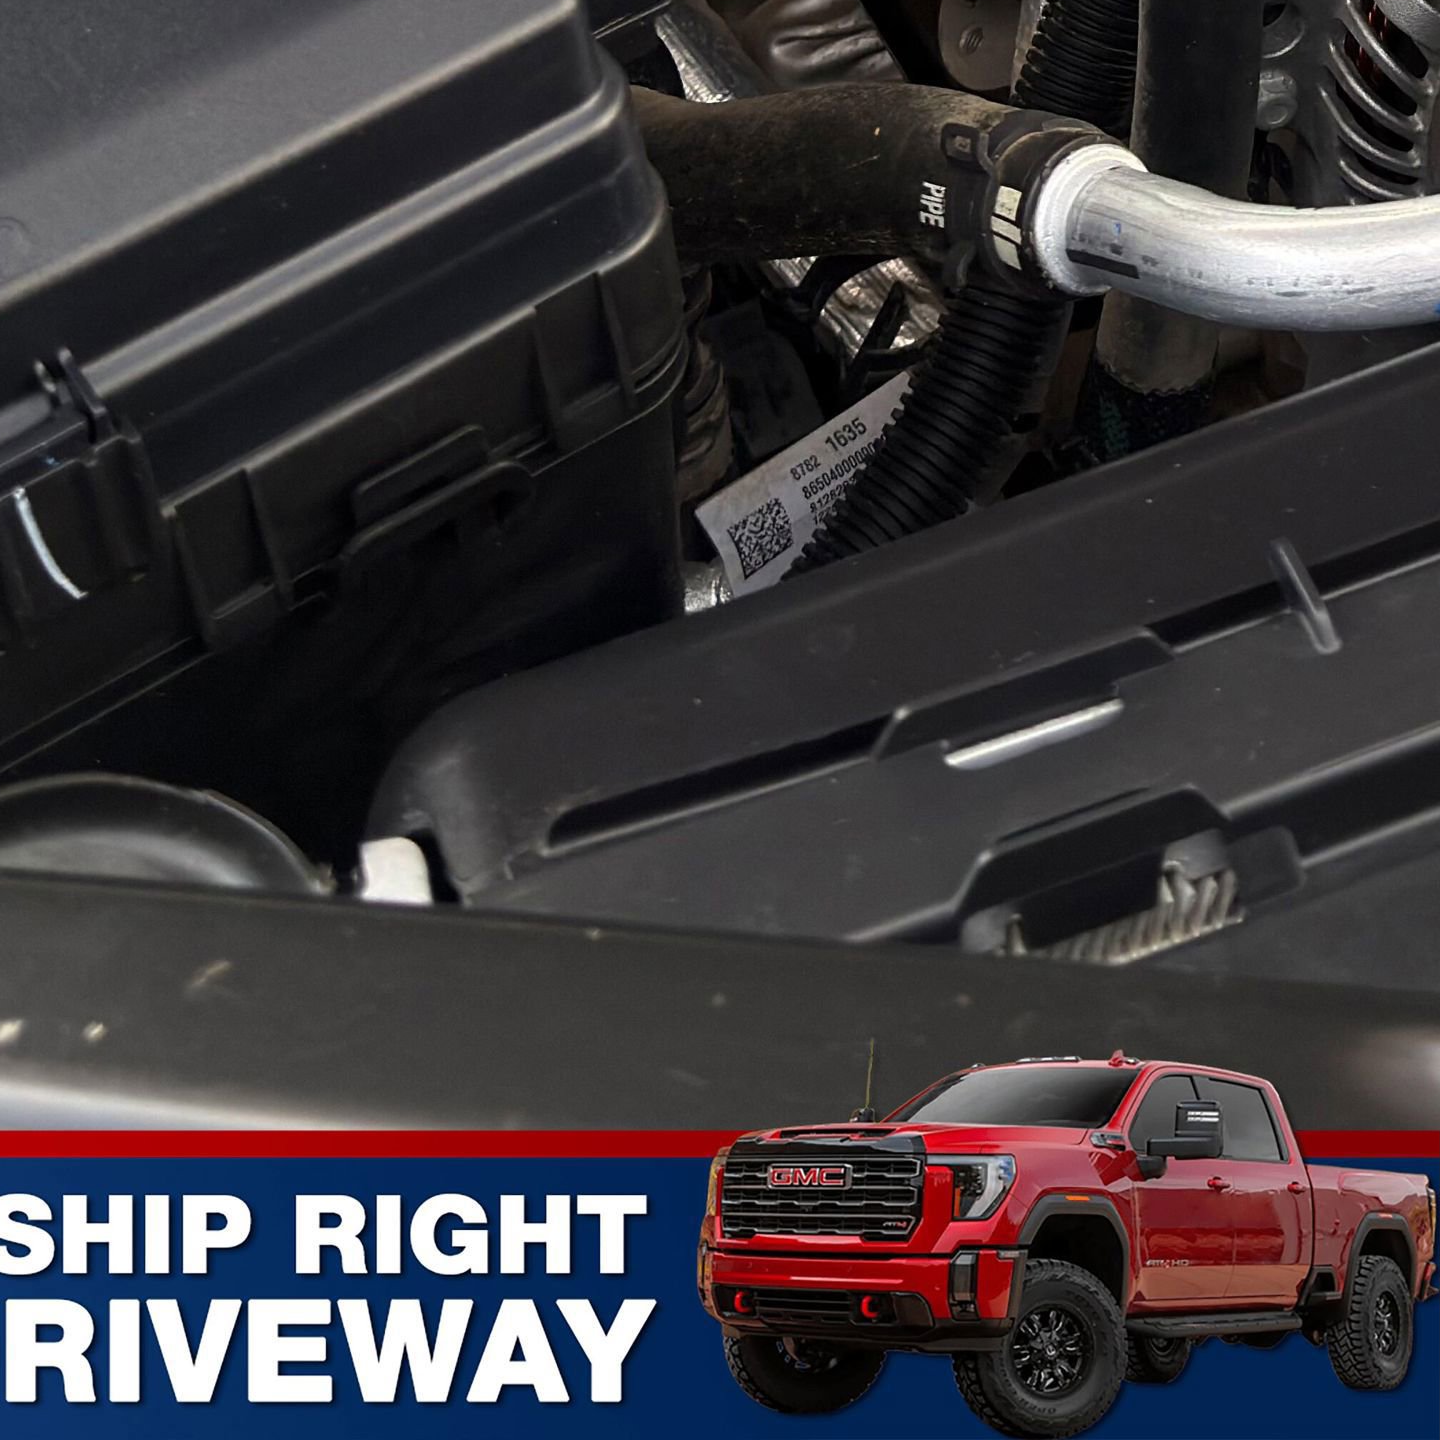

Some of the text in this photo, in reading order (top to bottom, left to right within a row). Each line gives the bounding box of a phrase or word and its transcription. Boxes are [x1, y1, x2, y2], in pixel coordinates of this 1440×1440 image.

[919, 181, 947, 229] PIPE
[789, 417, 867, 481] 8782 1635
